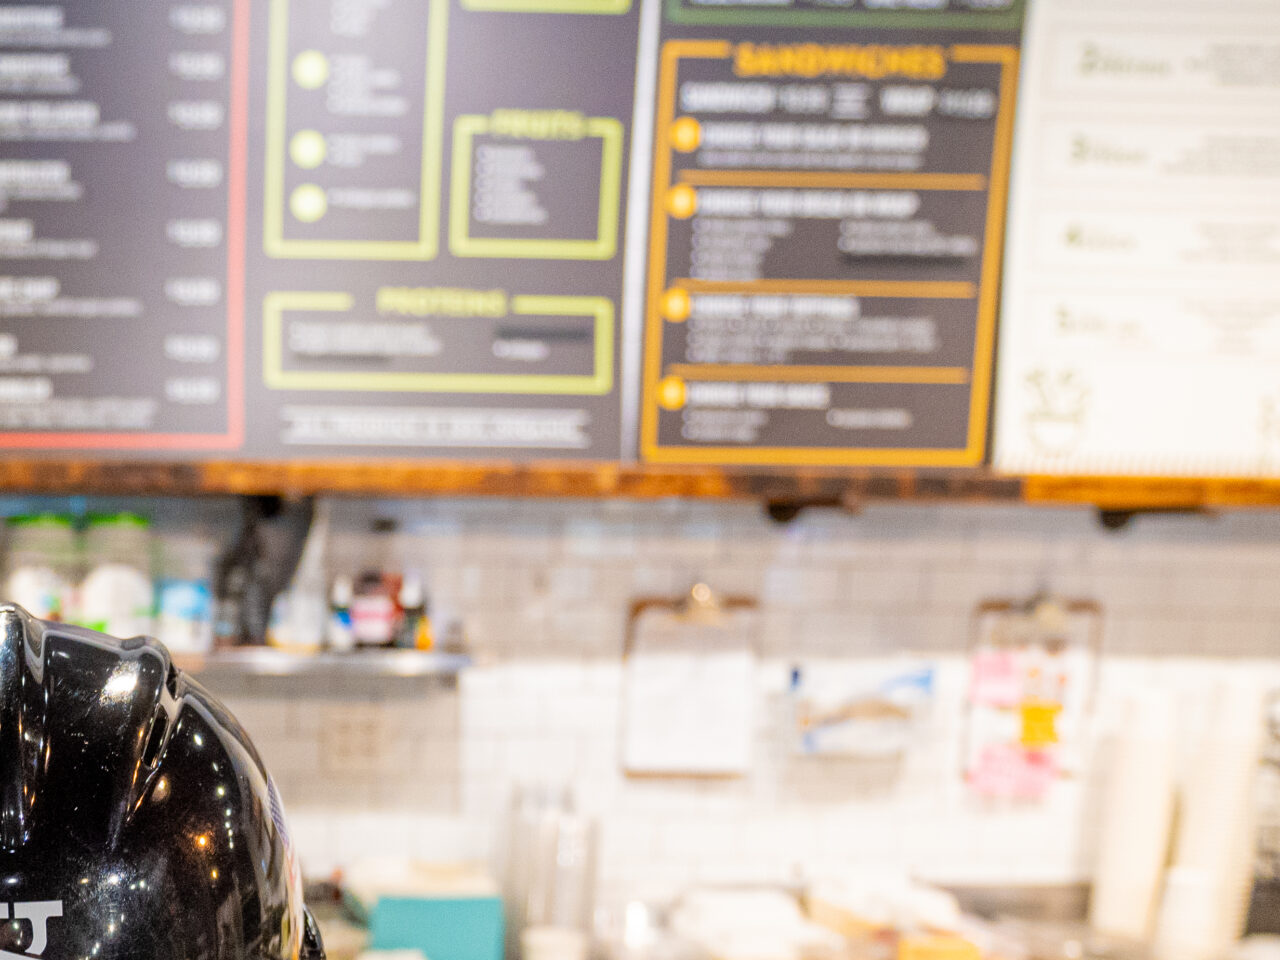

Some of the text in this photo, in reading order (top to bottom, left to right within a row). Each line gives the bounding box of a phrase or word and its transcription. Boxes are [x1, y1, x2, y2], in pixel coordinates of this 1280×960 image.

[734, 44, 946, 78] SANDWICHES
[491, 110, 586, 138] FRUITS
[377, 288, 508, 316] PROTEINS
